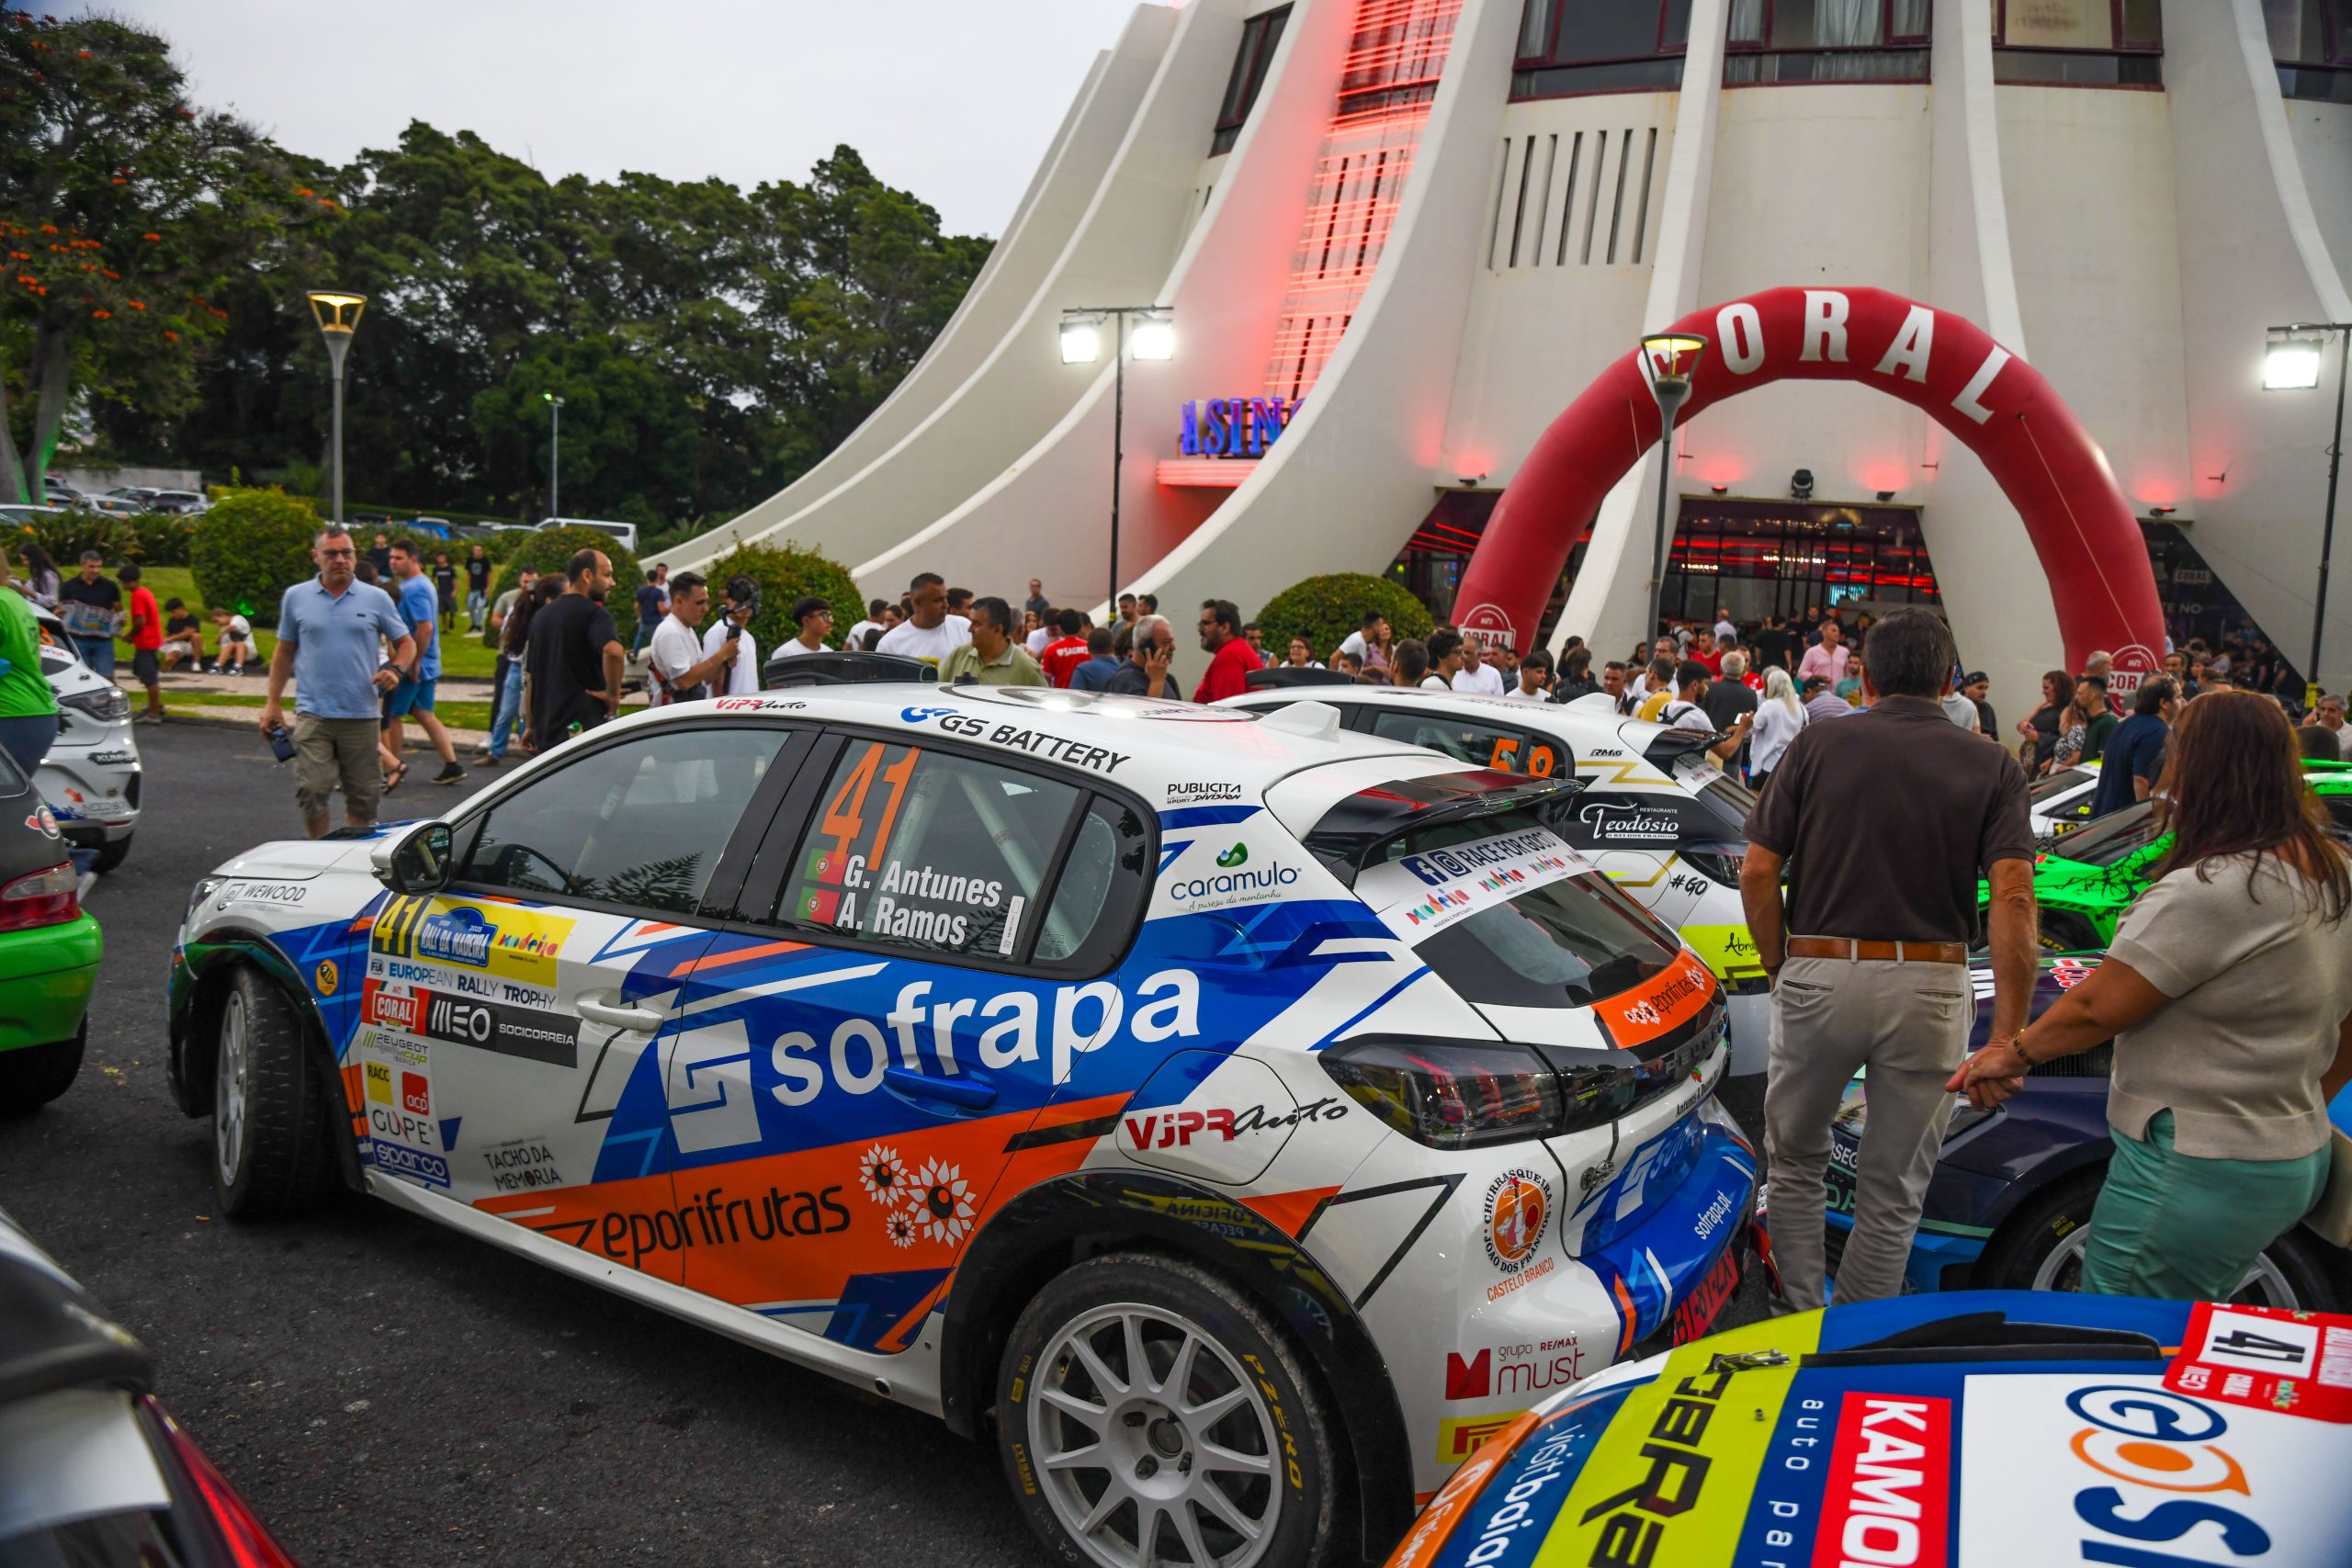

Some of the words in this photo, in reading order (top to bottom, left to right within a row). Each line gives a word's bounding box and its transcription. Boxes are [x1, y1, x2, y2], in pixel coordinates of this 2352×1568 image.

[1636, 289, 2011, 426] CORAL
[939, 714, 989, 738] GS
[989, 725, 1131, 774] BATTERY
[821, 741, 922, 872] 41
[1579, 803, 1679, 840] Teodósio
[245, 886, 307, 903] WEWOOD
[843, 855, 872, 890] G.
[880, 860, 1003, 908] Antunes
[375, 895, 424, 955] 41
[836, 892, 863, 931] A.
[874, 897, 967, 945] Ramos
[377, 997, 413, 1021] CORAL
[389, 962, 453, 987] EUROPEAN
[458, 974, 499, 998] RALLY
[503, 984, 557, 1010] TROPHY
[376, 1033, 429, 1055] PEUGEOT
[432, 999, 491, 1042] MEO
[499, 1023, 576, 1045] SOCICORREIA
[771, 968, 1201, 1107] sofrapa
[368, 1064, 390, 1083] RACC
[377, 1144, 447, 1179] sparco
[483, 1147, 531, 1171] TACHO
[532, 1145, 555, 1163] DA
[1484, 1168, 1553, 1224] CHURRASQUEIRA
[1694, 1190, 1733, 1240] sofrapa.pt
[603, 1185, 851, 1269] eporifrutas
[1500, 1263, 1519, 1273] DOS
[1521, 1211, 1552, 1269] FRANGOS
[1487, 1273, 1525, 1302] CASTELO
[1524, 1258, 1555, 1284] BRANCO
[1498, 1344, 1532, 1361] grupo
[1540, 1337, 1578, 1351] RE/MAX
[2211, 1330, 2306, 1363] 41
[1498, 1348, 1586, 1395] must
[1785, 1399, 1825, 1471] auto
[1840, 1400, 1928, 1568] KAMO
